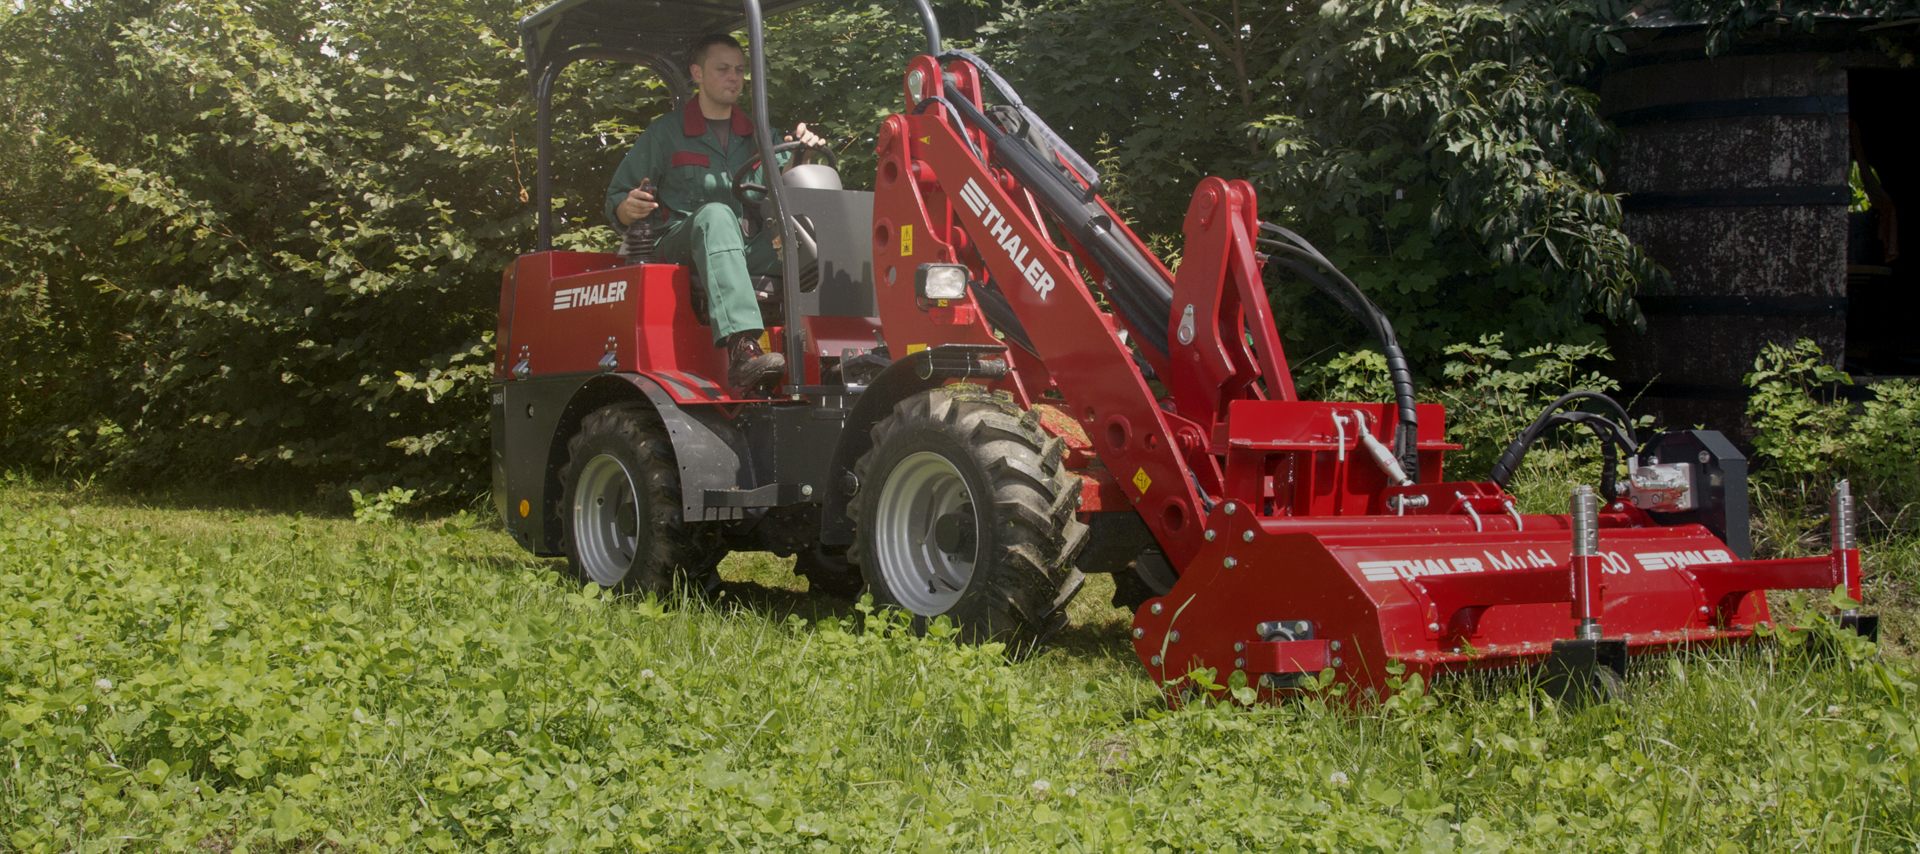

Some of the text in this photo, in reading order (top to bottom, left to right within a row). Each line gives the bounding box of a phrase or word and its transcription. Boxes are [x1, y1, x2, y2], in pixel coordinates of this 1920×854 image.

[982, 201, 1056, 301] THALER
[571, 280, 628, 308] THALER
[1388, 557, 1485, 579] THALER
[1658, 549, 1734, 568] THALER
